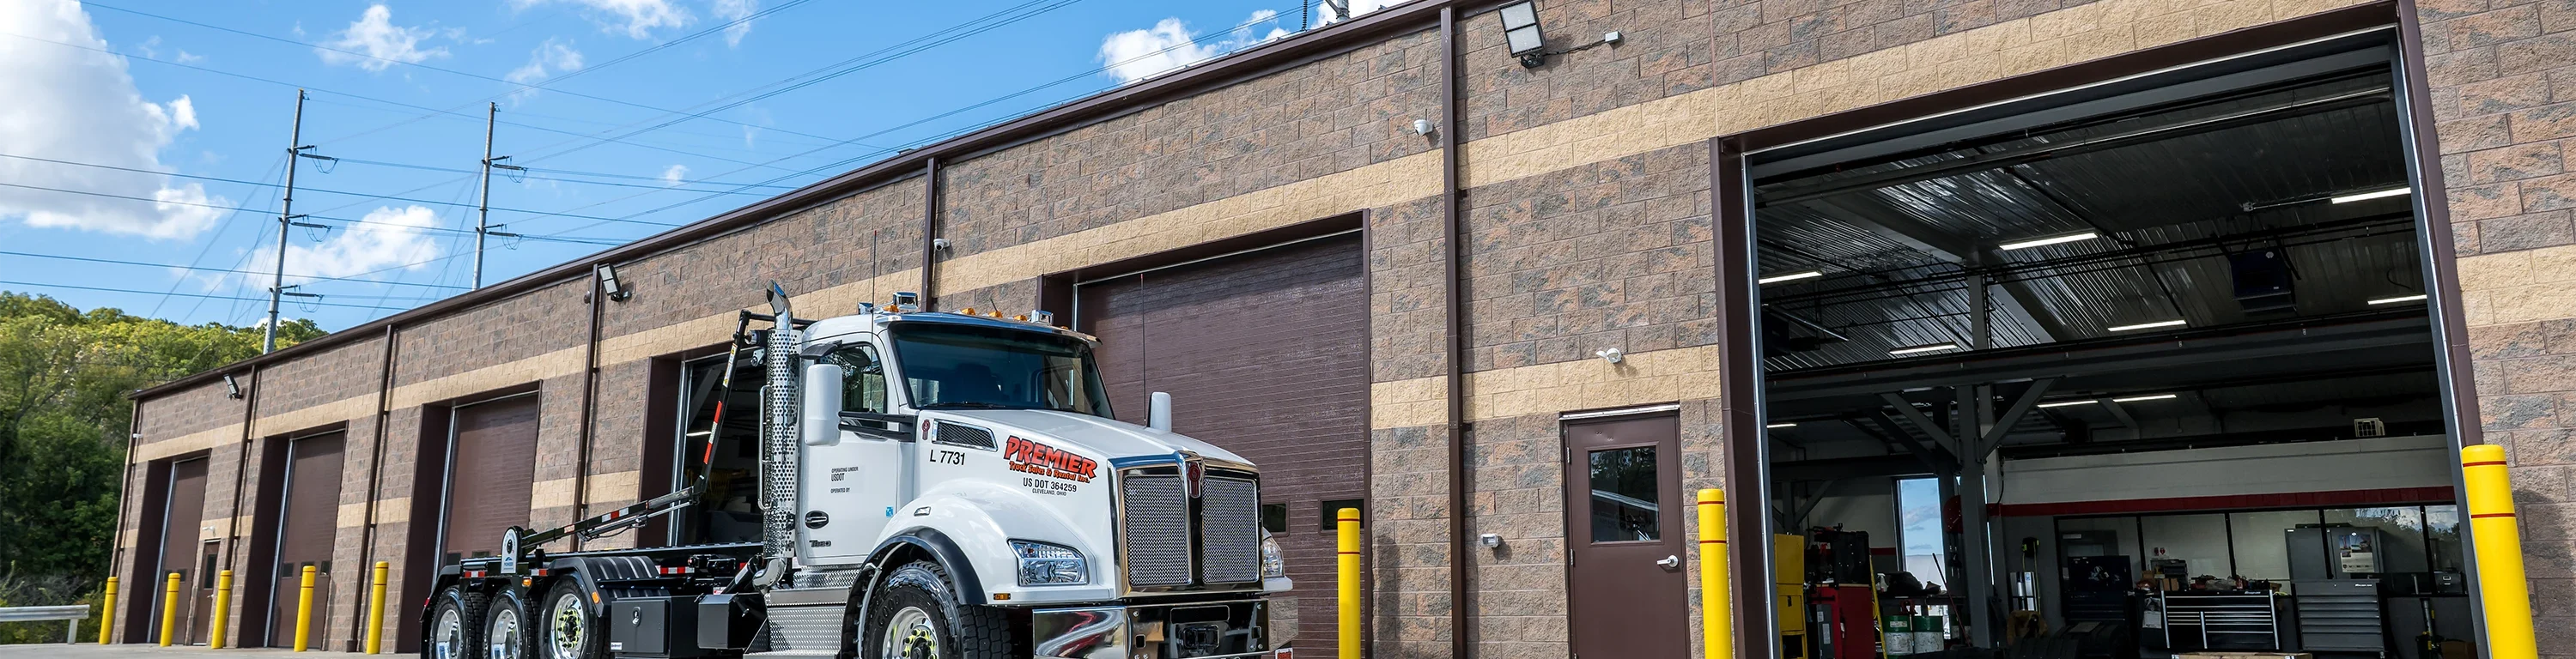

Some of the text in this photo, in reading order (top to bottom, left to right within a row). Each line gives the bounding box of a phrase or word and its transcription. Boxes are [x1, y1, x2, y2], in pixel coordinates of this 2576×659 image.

[930, 450, 965, 465] L 7731
[1004, 435, 1097, 479] PREMIER
[831, 473, 844, 481] USDOT
[1009, 461, 1026, 473] Truck
[1028, 464, 1045, 475] Sales
[1054, 469, 1075, 481] Rental
[1077, 475, 1090, 483] Inc.
[1023, 477, 1077, 492] US DOT 364259
